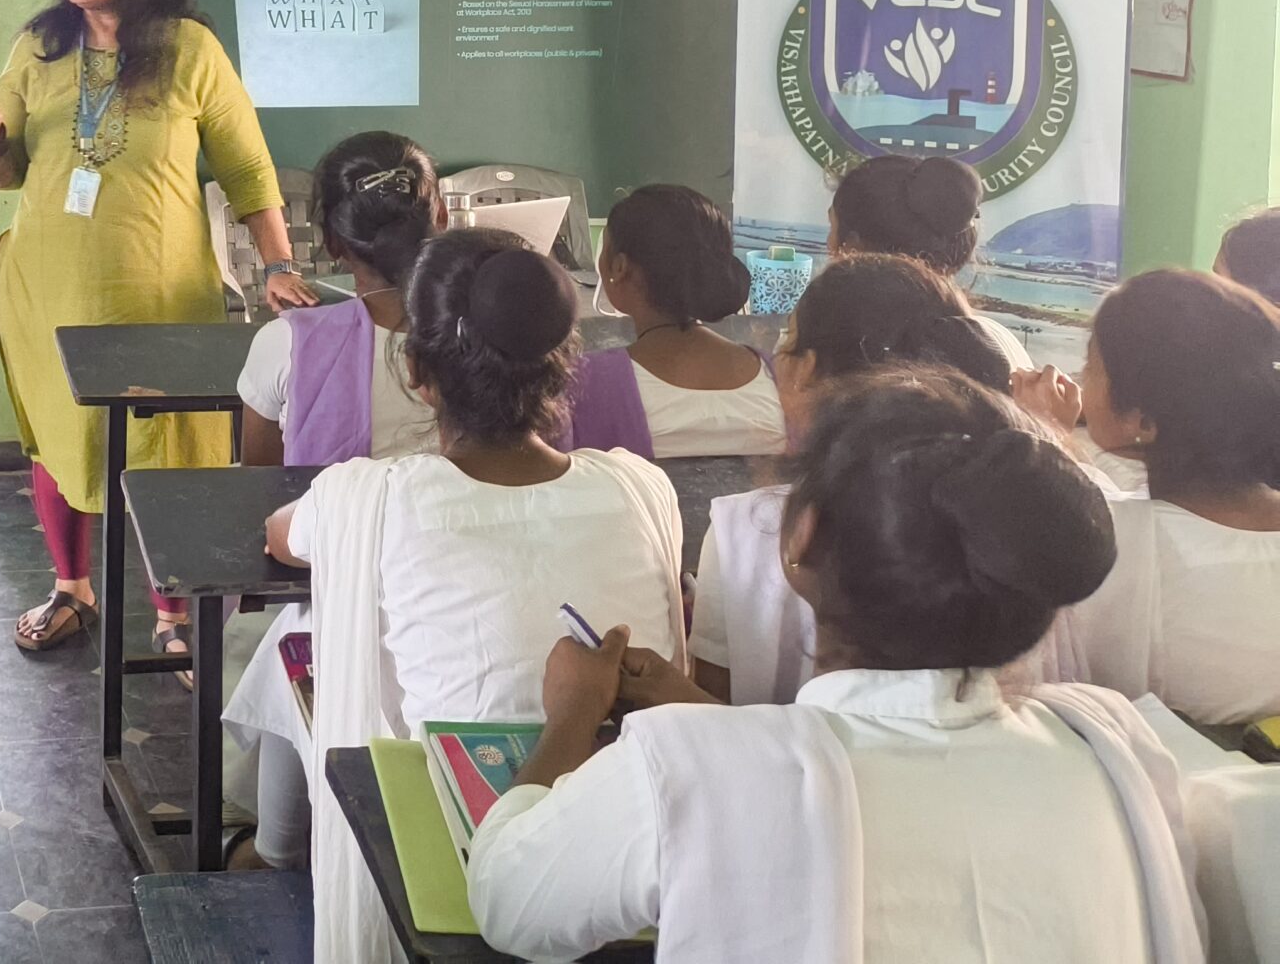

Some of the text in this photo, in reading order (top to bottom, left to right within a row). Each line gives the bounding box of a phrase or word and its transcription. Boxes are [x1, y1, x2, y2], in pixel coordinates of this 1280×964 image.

[267, 9, 379, 30] WHAT
[780, 28, 848, 173] VISAKHAPATNA
[980, 34, 1073, 193] URITY COUNCIL
